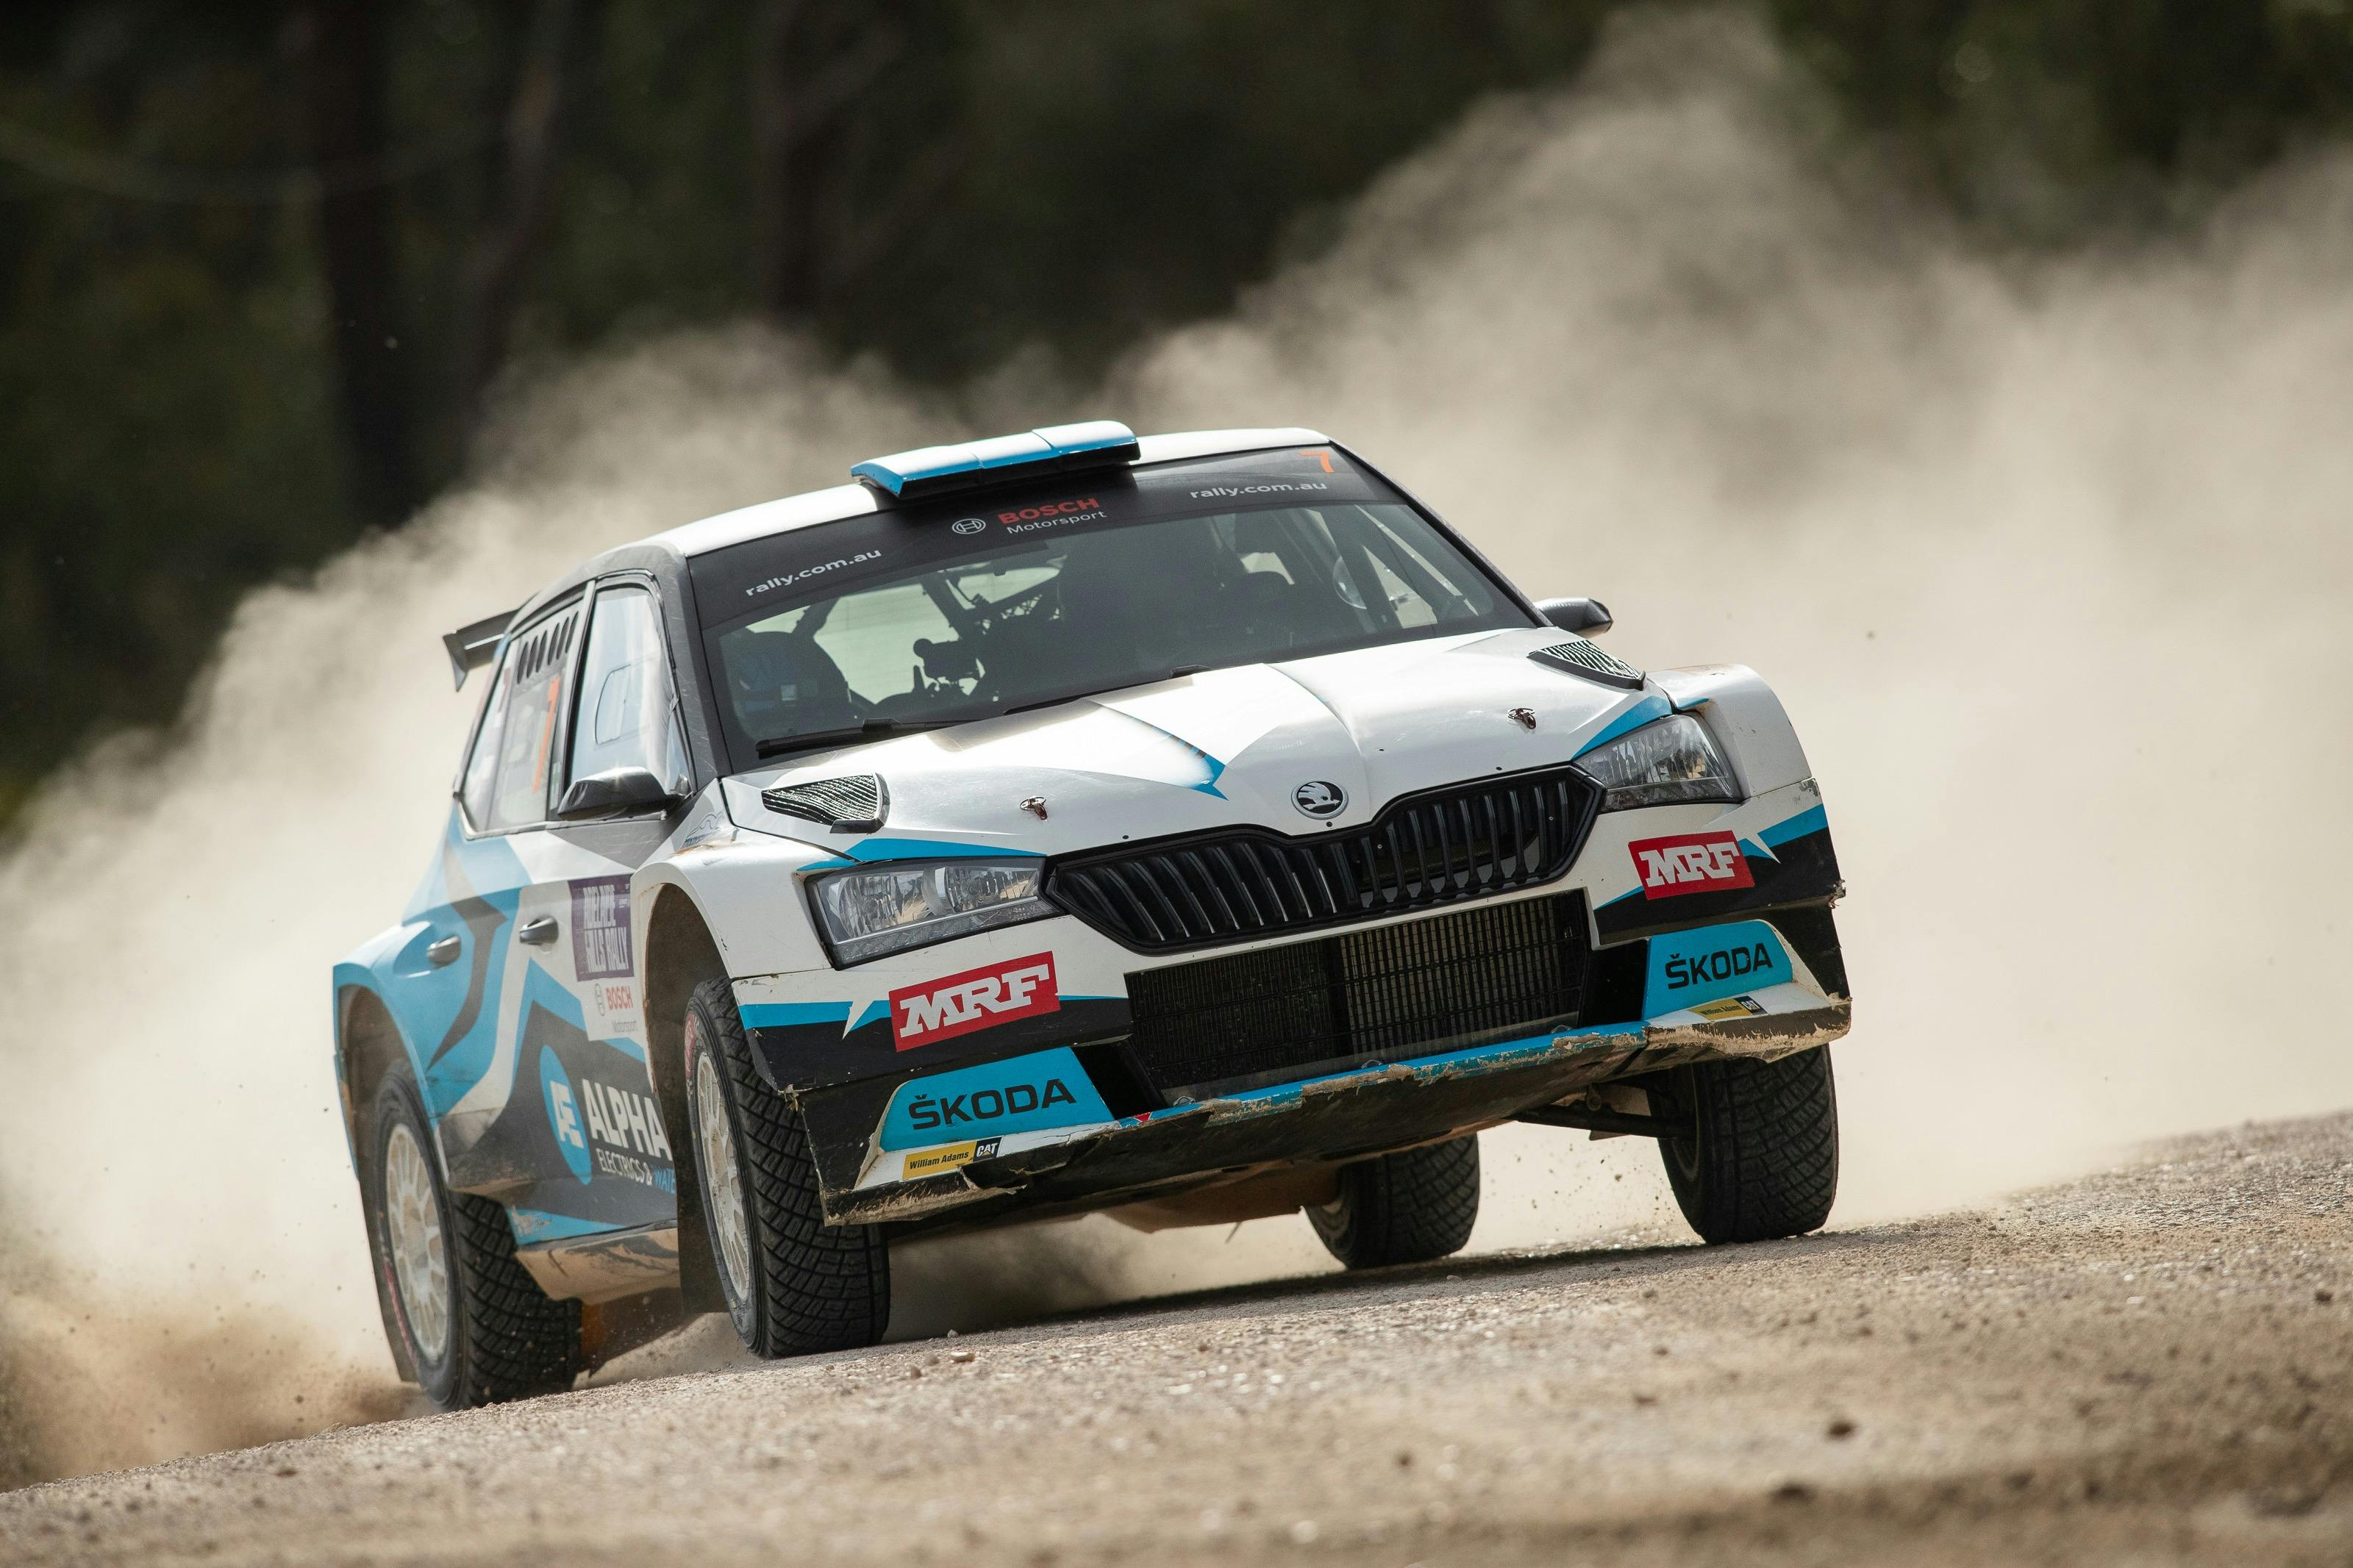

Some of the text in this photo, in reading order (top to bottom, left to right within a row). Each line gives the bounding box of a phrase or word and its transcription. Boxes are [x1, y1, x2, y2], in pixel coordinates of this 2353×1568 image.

[1298, 451, 1335, 474] 7
[1190, 482, 1327, 498] rally.com.au
[998, 498, 1100, 524] BOSCH
[1006, 511, 1107, 534] Motorsport
[746, 550, 882, 596] rally.com.au
[1638, 841, 1740, 887] MRF
[1665, 942, 1774, 989] ŠKODA
[605, 985, 634, 1011] BOSCH
[899, 963, 1050, 1038] MRF
[582, 1078, 674, 1161] ALPHA
[908, 1078, 1077, 1130] ŠKODA
[910, 1151, 970, 1170] William Adams
[976, 1142, 999, 1158] CAT
[596, 1148, 645, 1184] ELECTRICS
[643, 1161, 653, 1186] &
